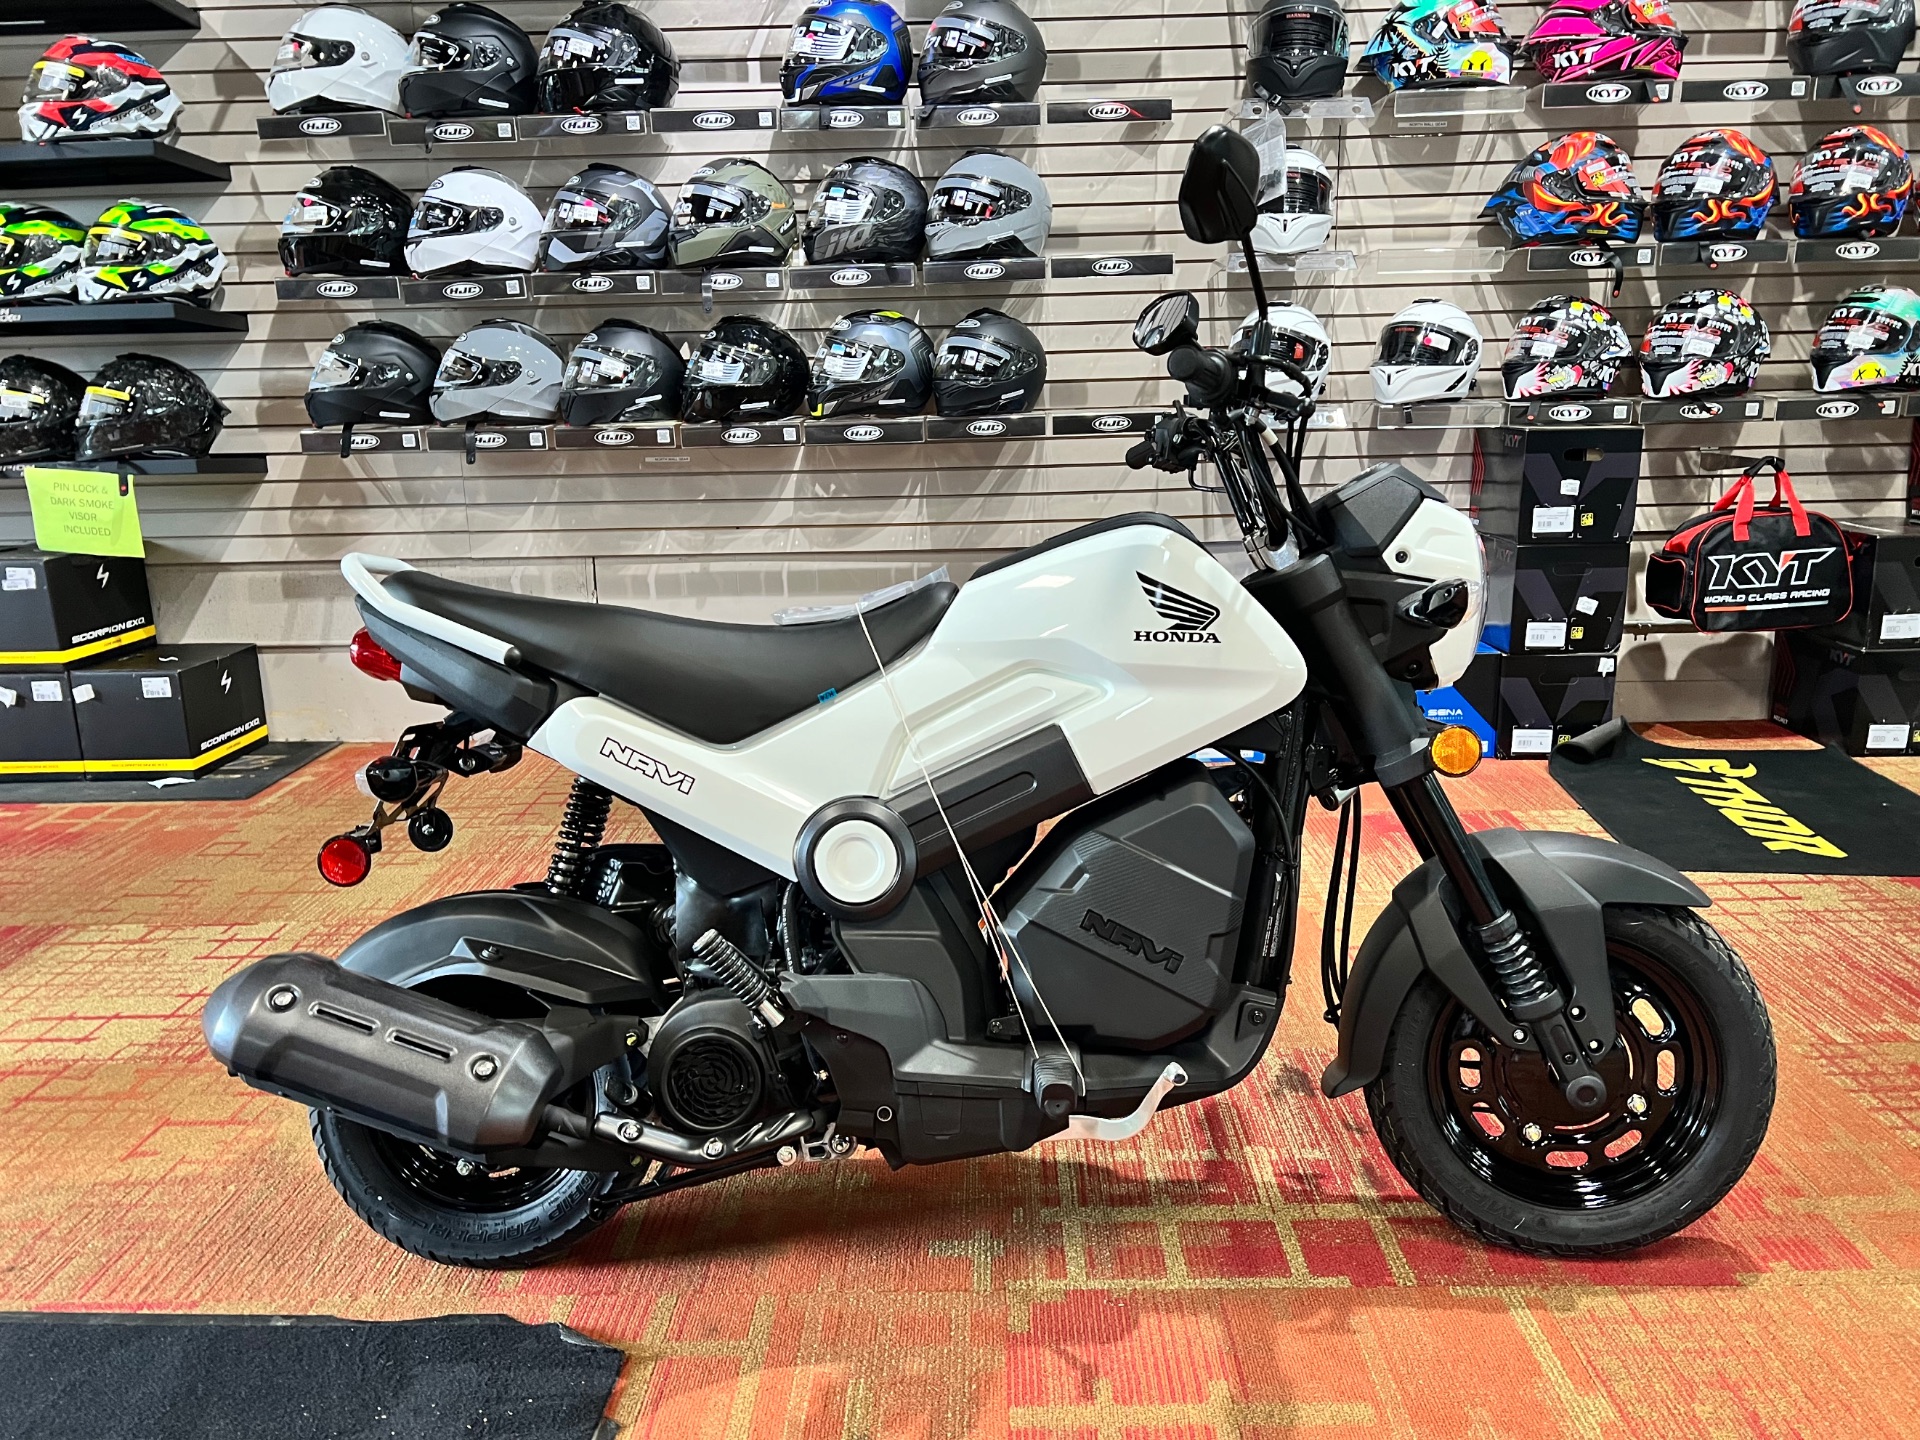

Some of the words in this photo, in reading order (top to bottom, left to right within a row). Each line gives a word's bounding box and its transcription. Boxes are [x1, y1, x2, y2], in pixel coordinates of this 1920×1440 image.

[1552, 45, 1602, 68] KYT
[1392, 55, 1437, 77] KYT
[1730, 85, 1762, 96] KYT
[1862, 80, 1895, 91] KYT
[1593, 88, 1626, 98] KYT
[963, 111, 993, 121] HJC
[1094, 106, 1124, 116] HJC
[566, 120, 597, 130] HJC
[699, 115, 729, 125] HJC
[305, 120, 336, 131] HJC
[438, 127, 468, 137] HJC
[1844, 245, 1872, 256] KYT
[969, 266, 1000, 276] HJC
[1097, 262, 1127, 271] HJC
[836, 272, 866, 282] HJC
[324, 284, 352, 294] HJC
[578, 279, 608, 289] HJC
[448, 286, 478, 296] HJC
[1555, 407, 1586, 418] KYT
[1823, 405, 1854, 415] KYT
[971, 422, 1001, 432] HJC
[1097, 418, 1127, 428] HJC
[600, 432, 629, 442] HJC
[727, 431, 755, 440] HJC
[849, 428, 878, 438] HJC
[53, 481, 70, 491] PIN
[73, 483, 99, 494] LOCK
[50, 496, 76, 506] DARK
[79, 498, 115, 510] SMOKE
[69, 511, 97, 521] VISOR
[63, 524, 111, 537] INCLUDED
[1708, 547, 1836, 590] KYT
[1704, 594, 1745, 604] WORLD
[1748, 592, 1787, 601] CLASS
[1790, 588, 1830, 598] RACING
[71, 622, 126, 644] SCORPION
[126, 616, 145, 629] EXO
[1133, 631, 1221, 644] HONDA
[200, 725, 245, 750] SCORPION
[244, 717, 260, 731] EXO
[1674, 776, 1849, 858] THOR
